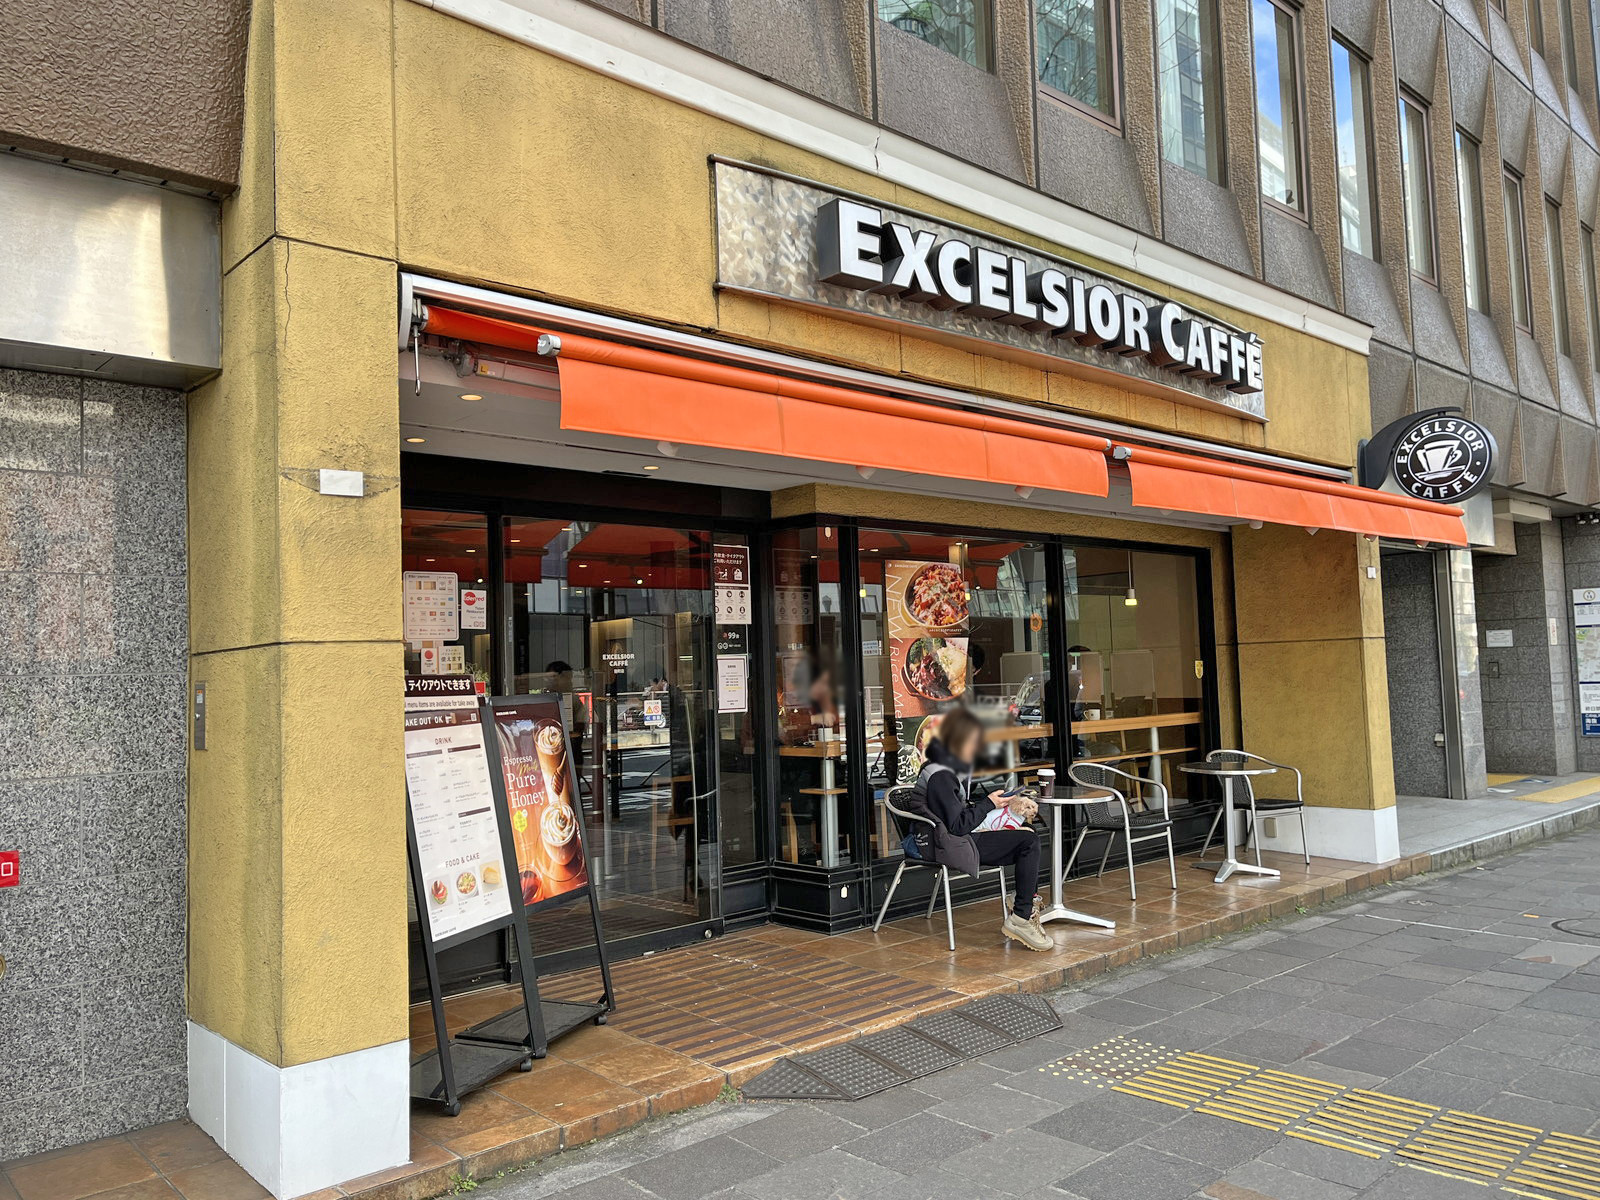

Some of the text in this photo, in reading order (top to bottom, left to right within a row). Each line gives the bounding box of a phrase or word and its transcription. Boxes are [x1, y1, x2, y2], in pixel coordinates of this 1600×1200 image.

[836, 198, 1264, 393] EXCELSIOR CAFFÉ
[1396, 421, 1485, 464] EXCELSIOR
[602, 653, 635, 661] EXCELSIOR
[885, 573, 905, 742] NEW Rice Menu
[408, 678, 471, 691] テイクアウトできます
[405, 715, 444, 727] AKE OUT OK
[435, 737, 452, 745] DRINK
[503, 755, 533, 766] Espresso
[506, 772, 537, 790] Pure
[510, 790, 545, 809] Honey
[445, 858, 460, 868] FOOD
[465, 852, 480, 863] CAKE
